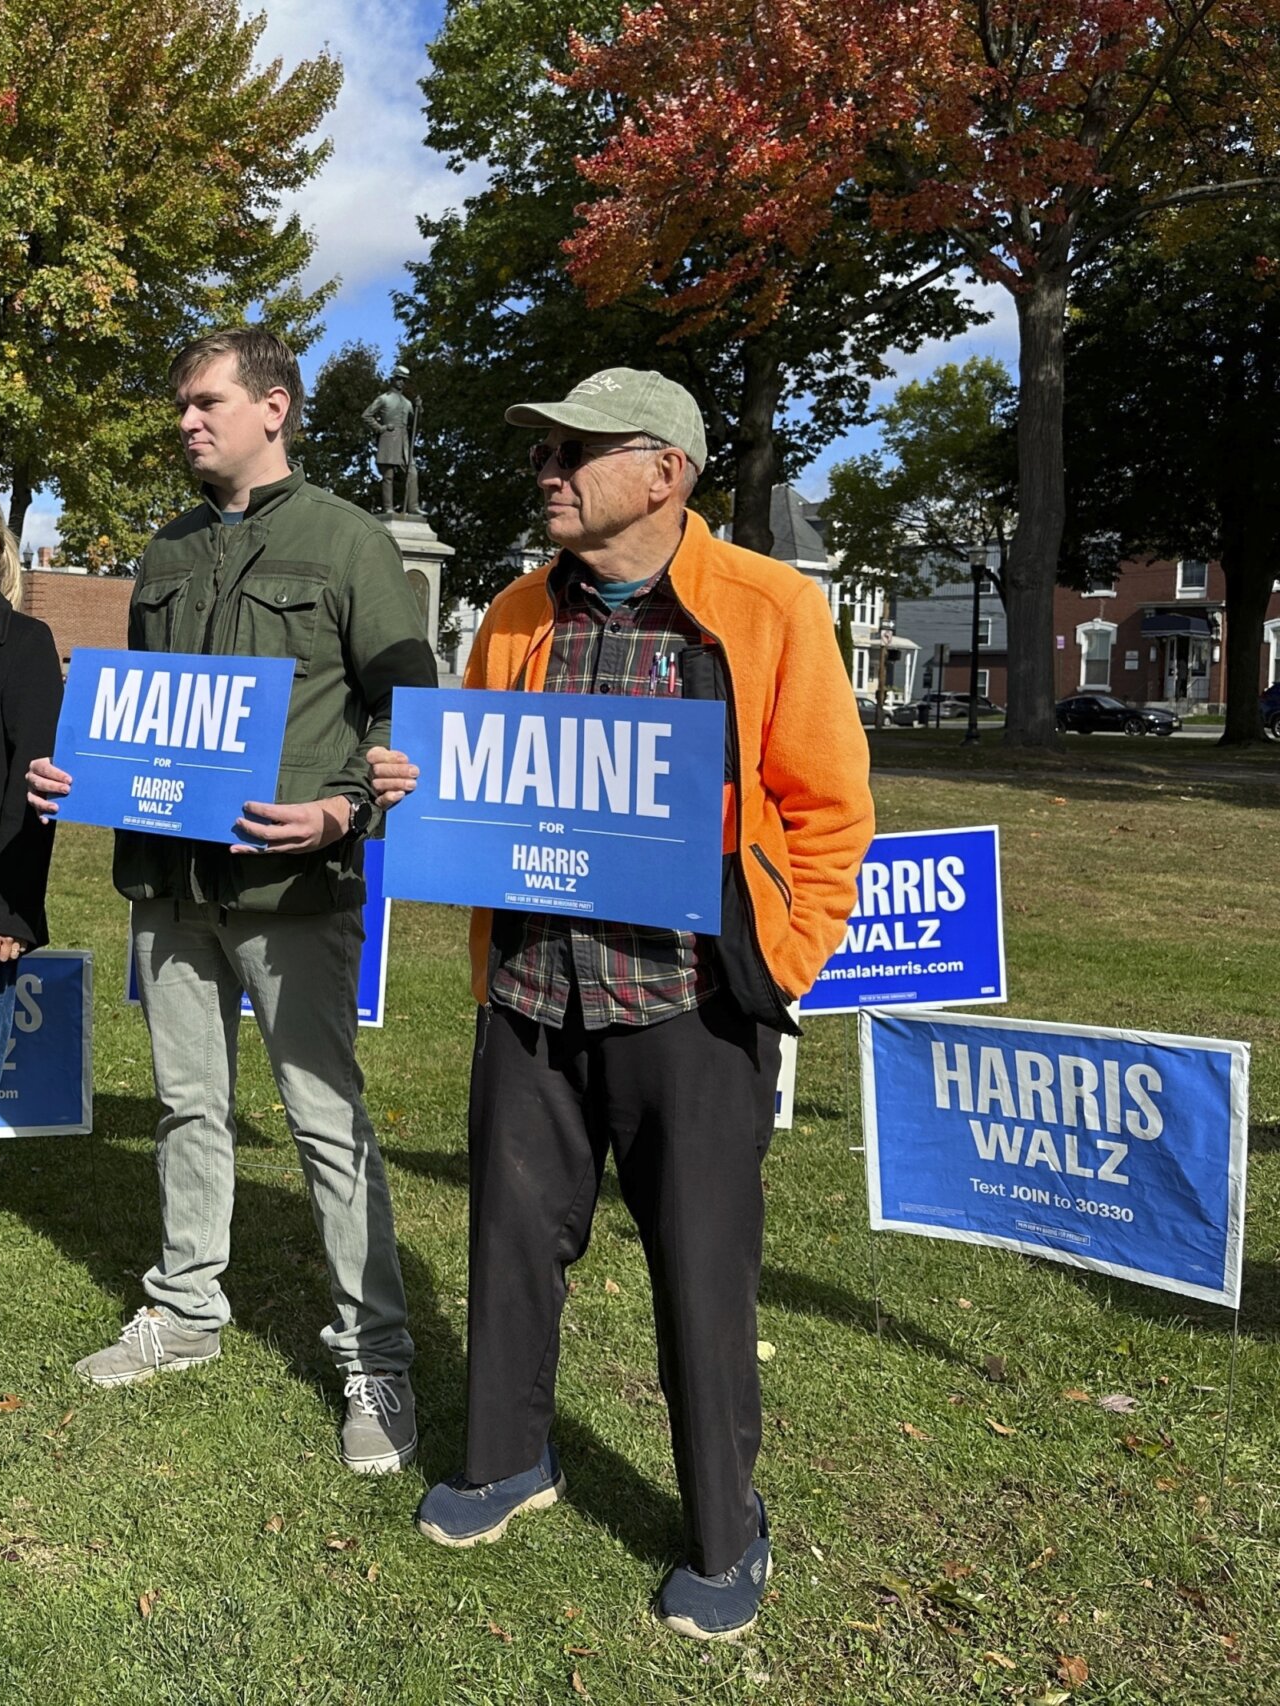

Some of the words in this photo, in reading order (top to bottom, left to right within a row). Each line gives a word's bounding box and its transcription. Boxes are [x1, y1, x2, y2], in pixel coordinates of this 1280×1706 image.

[89, 667, 257, 753] MAINE
[153, 757, 172, 768] FOR
[439, 711, 672, 818] MAINE
[131, 776, 184, 803] HARRIS
[138, 800, 174, 815] WALZ
[539, 822, 565, 834] FOR
[512, 844, 589, 877] HARRIS
[524, 873, 577, 893] WALZ
[849, 856, 966, 917] RRIS
[930, 1041, 1164, 1141] HARRIS
[969, 1119, 1129, 1185] WALZ
[970, 1177, 1006, 1197] Text
[1010, 1185, 1050, 1205] JOIN
[1054, 1196, 1071, 1209] to
[1075, 1198, 1134, 1223] 30330
